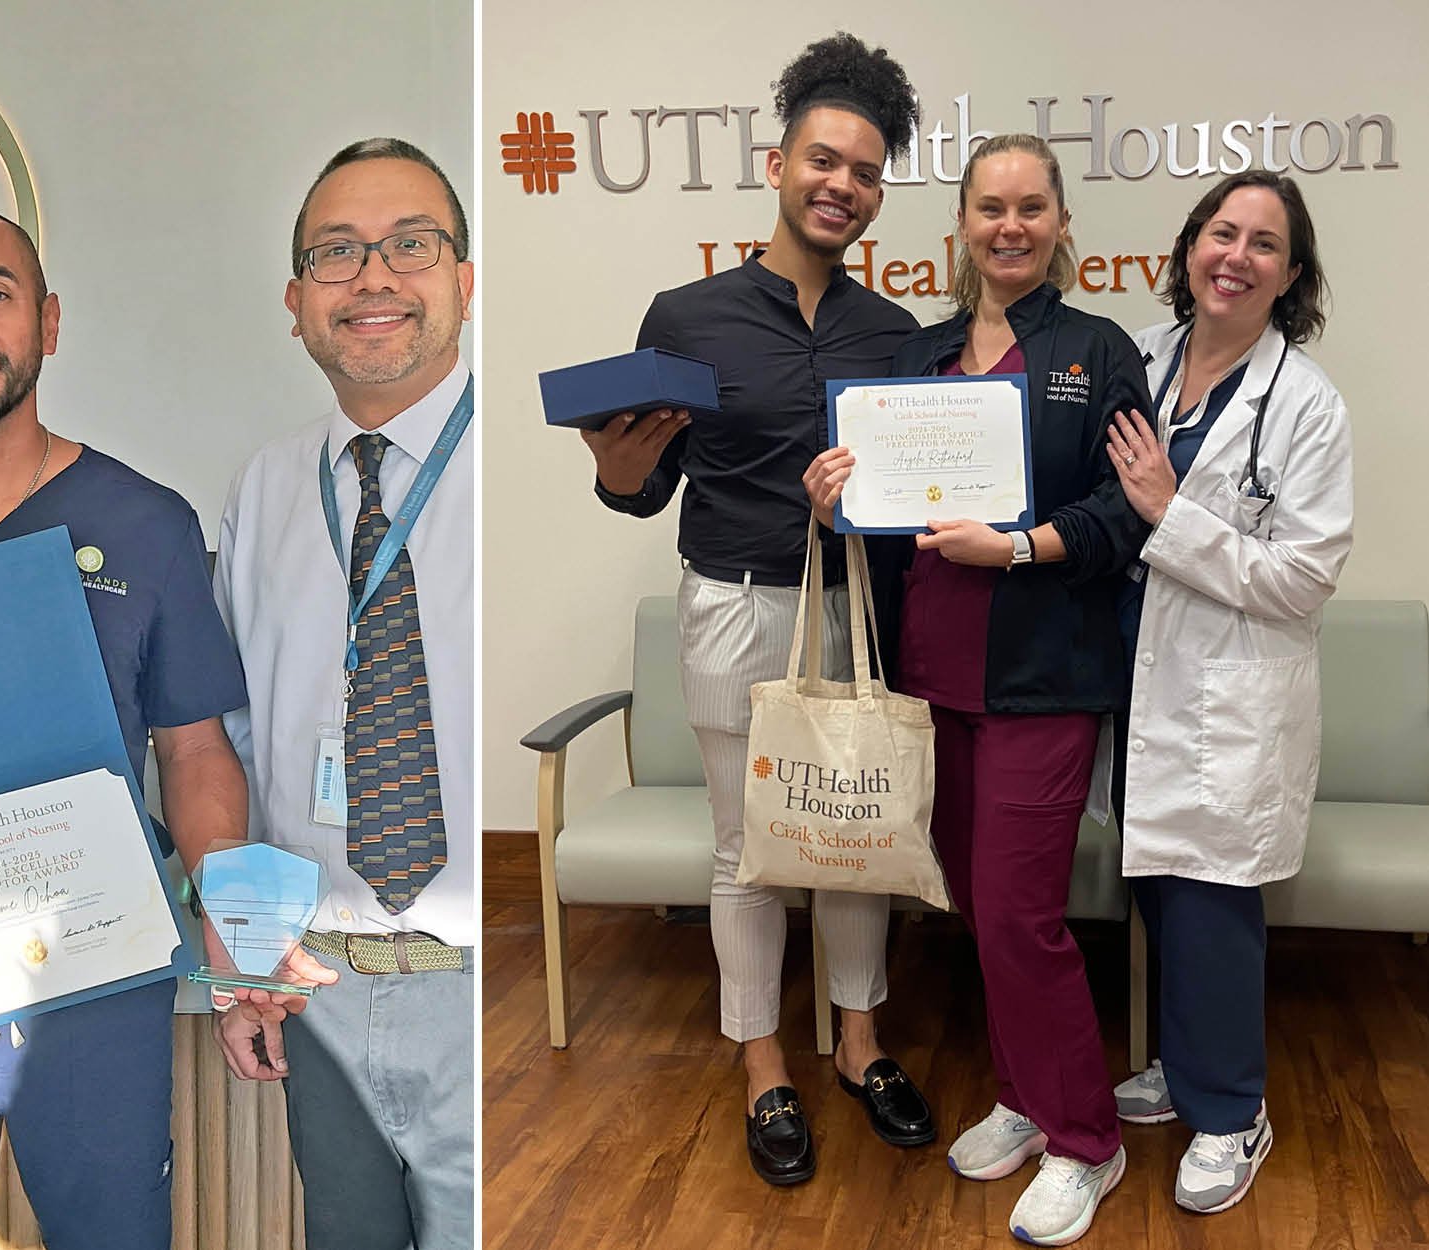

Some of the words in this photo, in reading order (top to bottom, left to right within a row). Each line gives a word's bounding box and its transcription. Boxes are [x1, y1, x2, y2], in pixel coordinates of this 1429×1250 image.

[1028, 94, 1400, 181] Houston
[888, 396, 938, 408] UTHealth
[941, 395, 983, 406] Houston
[83, 581, 127, 596] HEALTHCARE
[776, 757, 891, 795] UTHealth
[12, 800, 73, 823] Houston
[785, 786, 882, 821] Houston
[27, 821, 71, 839] Nursing
[770, 820, 812, 844] Cizik
[818, 829, 872, 849] School
[877, 831, 897, 849] of
[4, 848, 86, 878] EXCELLENCE
[34, 861, 80, 880] AWARD
[798, 847, 867, 871] Nursing
